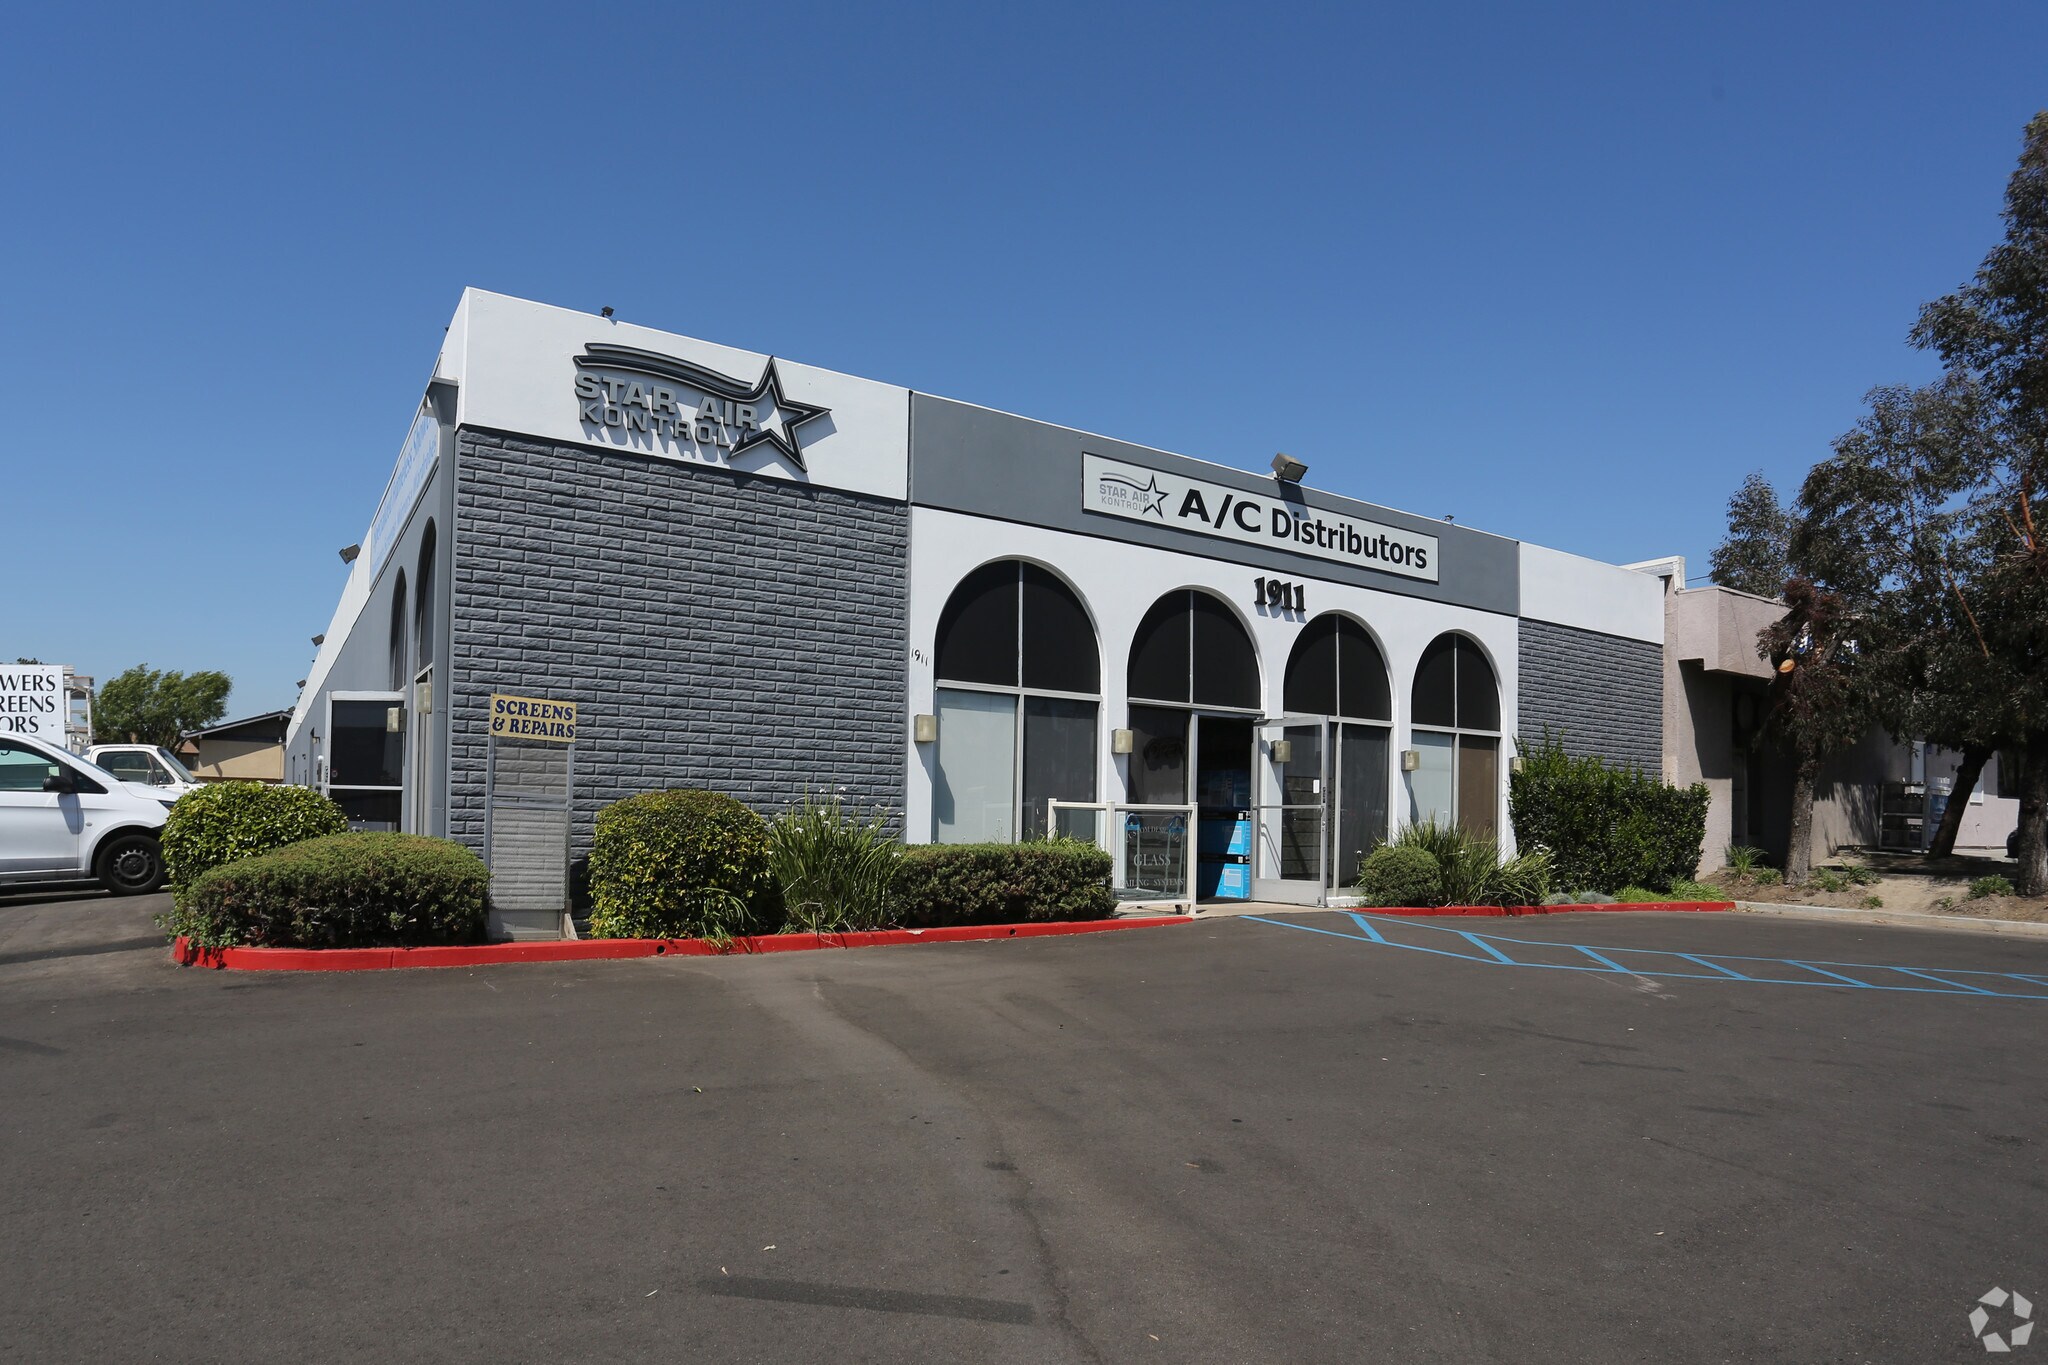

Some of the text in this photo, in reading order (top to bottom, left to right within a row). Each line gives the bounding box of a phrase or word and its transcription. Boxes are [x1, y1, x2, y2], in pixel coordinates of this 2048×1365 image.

[575, 372, 758, 430] STAR AIR
[579, 401, 731, 448] KONTROL
[1099, 484, 1150, 504] STAR AIR
[1101, 496, 1143, 512] KONTROL
[1178, 488, 1427, 569] A/C Distributors
[1254, 576, 1306, 612] 1911
[911, 648, 928, 667] 1911
[495, 699, 573, 721] SCREENS
[492, 716, 574, 738] & REPAIRS
[1133, 853, 1171, 867] GLASS
[1121, 879, 1149, 888] RAILNG
